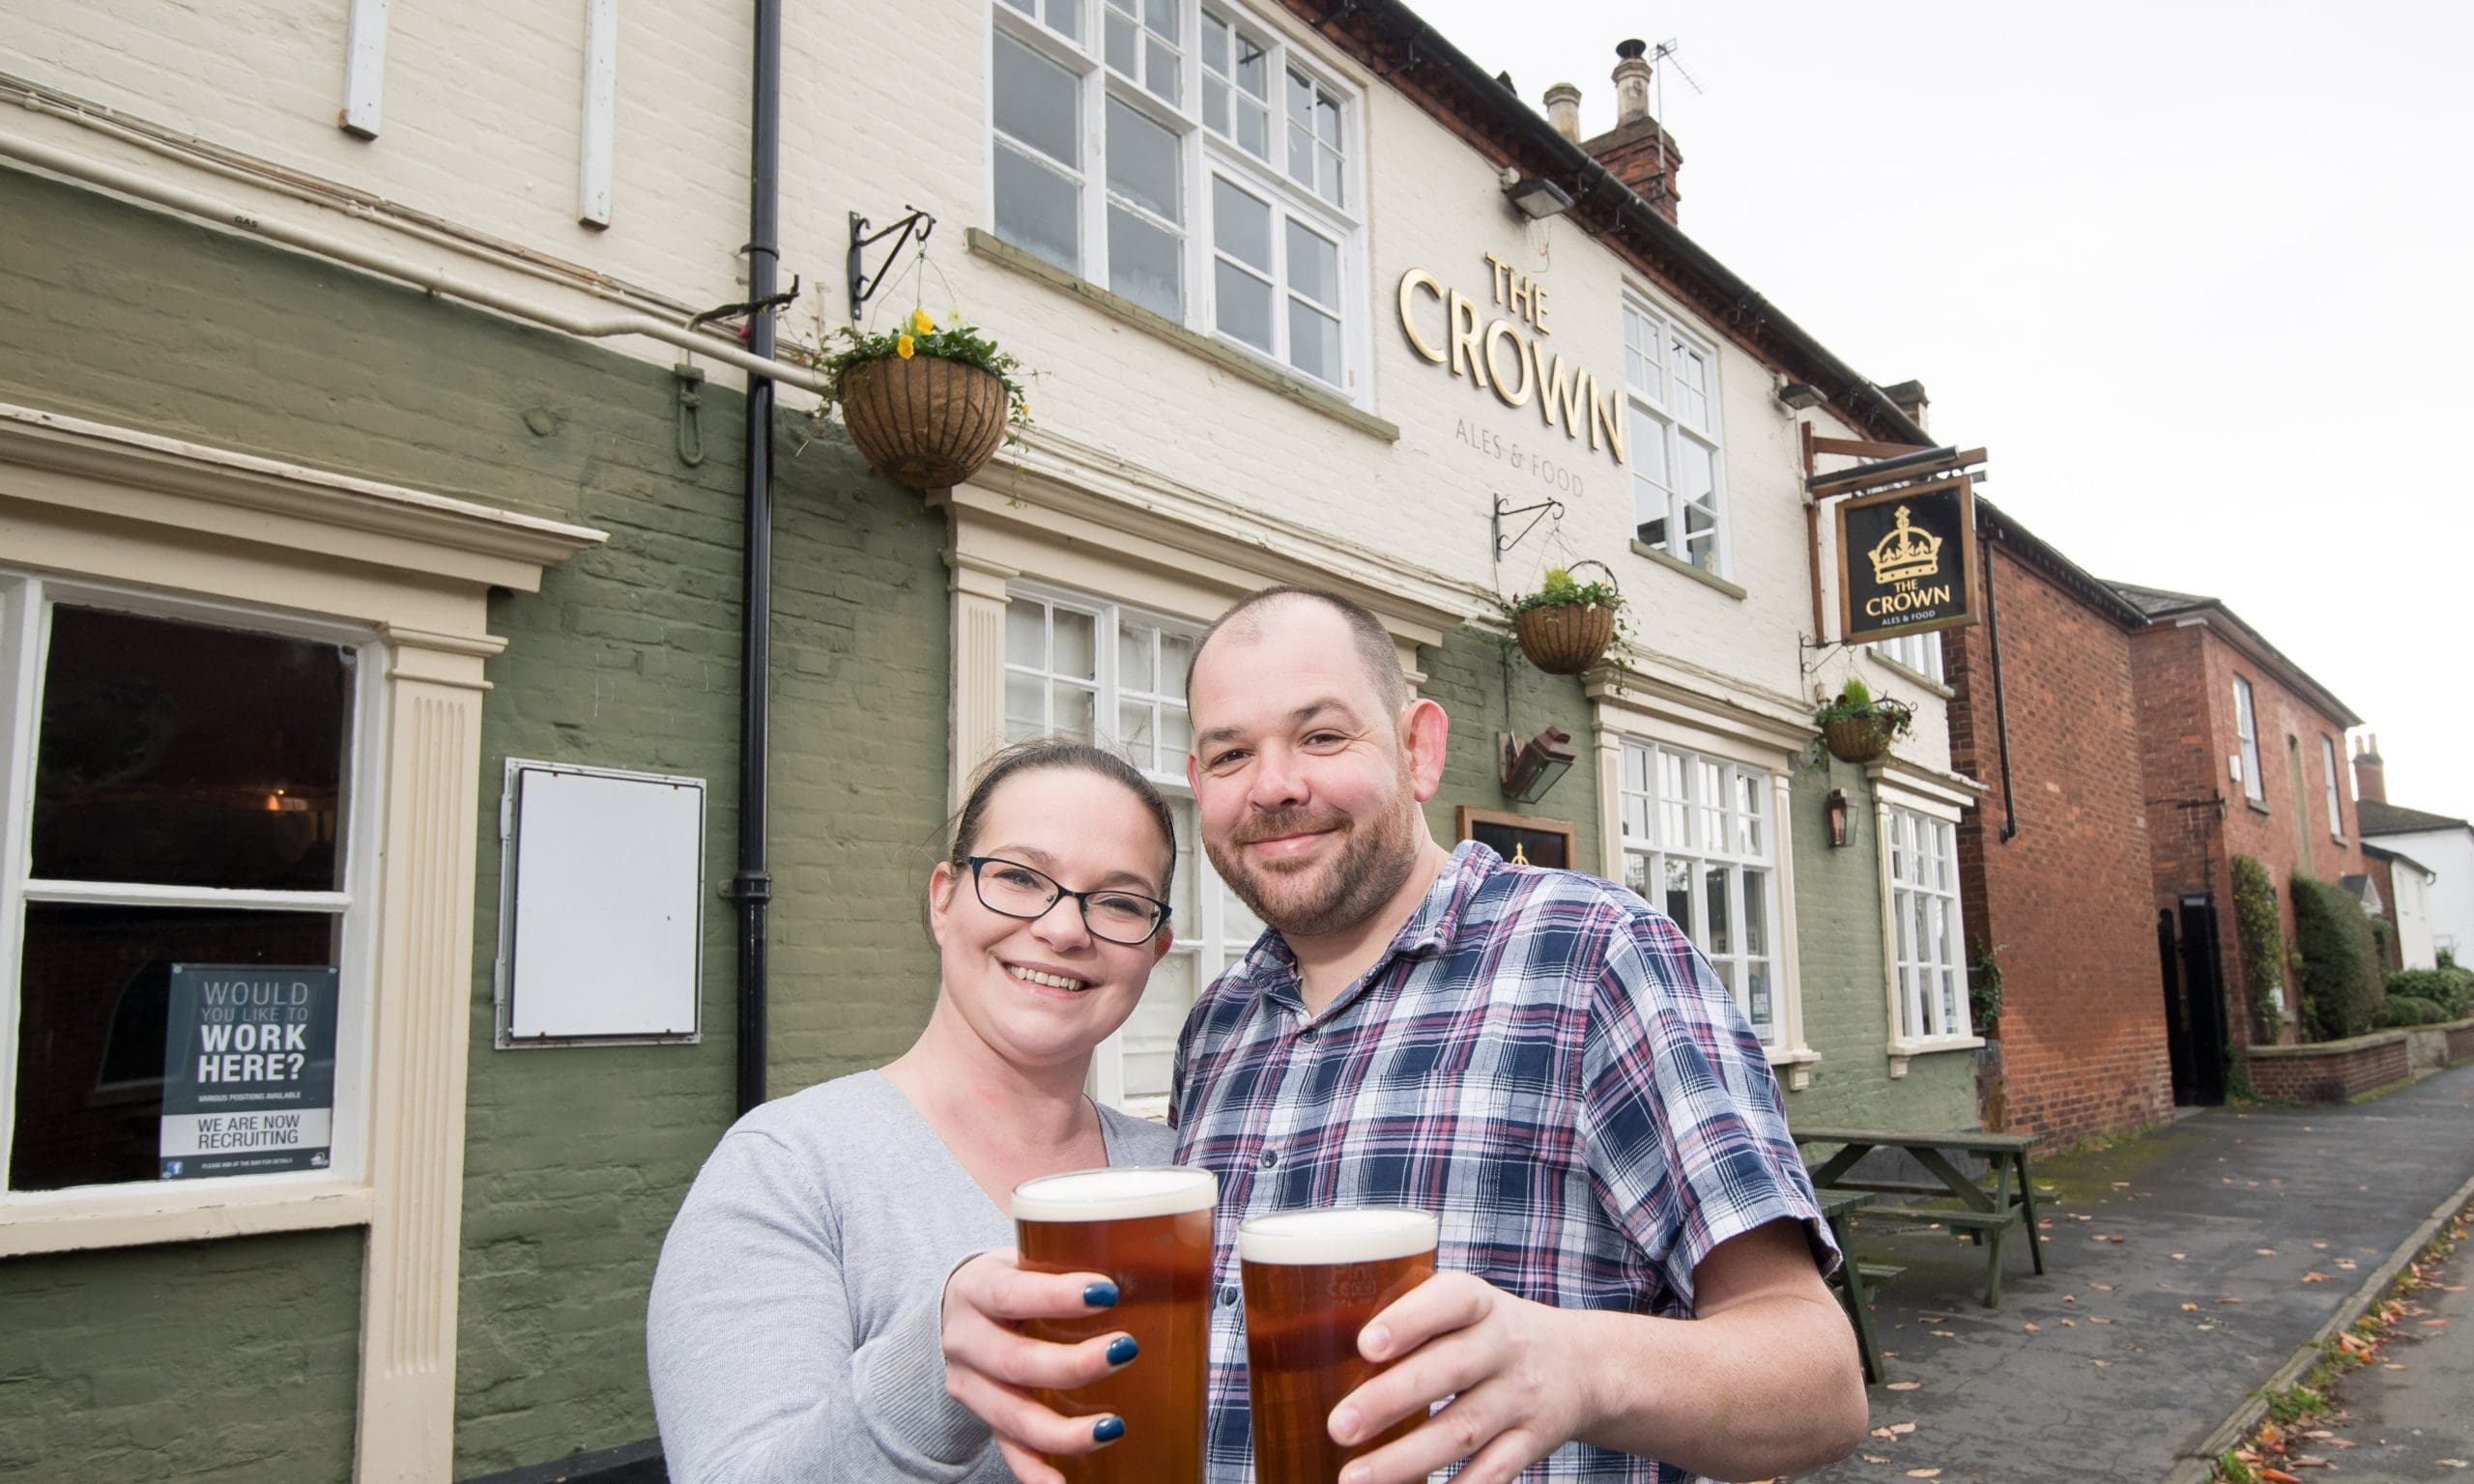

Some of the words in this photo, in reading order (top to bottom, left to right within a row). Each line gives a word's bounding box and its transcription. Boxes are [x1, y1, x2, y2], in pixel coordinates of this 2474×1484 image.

[234, 215, 258, 228] GAS
[1484, 251, 1550, 335] THE
[1399, 267, 1625, 465] CROWN
[1455, 418, 1502, 459] ALES
[1510, 443, 1523, 469] &
[1532, 454, 1584, 498] FOOD
[1894, 579, 1918, 592] THE
[1865, 585, 1950, 616] CROWN
[1882, 616, 1901, 626] ALES
[1912, 610, 1936, 621] FOOD
[204, 982, 309, 1006] WOULD
[202, 1008, 235, 1022] YOU
[243, 1007, 279, 1021] LIKE
[288, 1007, 309, 1021] TO
[200, 1023, 307, 1052] WORK
[197, 1053, 305, 1083] HERE?
[229, 1093, 265, 1101] POSITIONS
[266, 1091, 302, 1099] AVAILABLE
[198, 1118, 223, 1132] WE
[227, 1116, 259, 1131] ARE
[264, 1114, 301, 1129] NOW
[198, 1129, 299, 1150] RECRUITING
